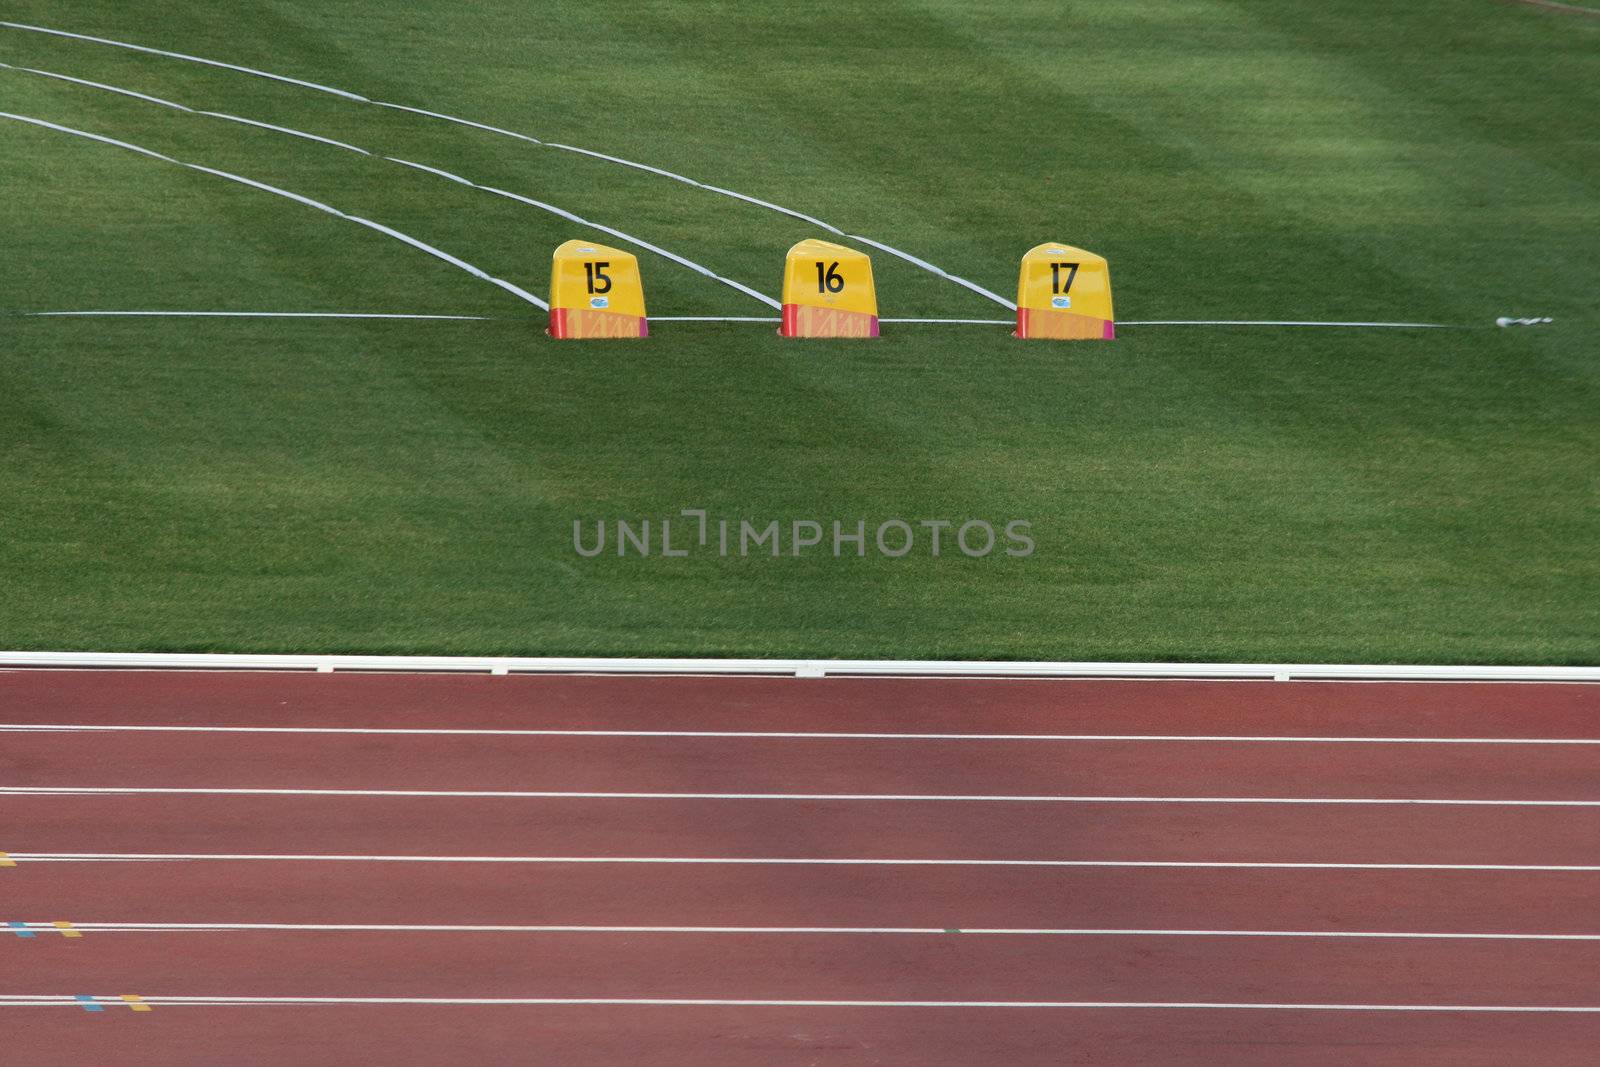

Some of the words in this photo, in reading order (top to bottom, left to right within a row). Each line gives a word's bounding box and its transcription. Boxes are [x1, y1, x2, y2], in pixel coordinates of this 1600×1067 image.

[584, 262, 612, 294] 15
[815, 261, 845, 294] 16
[1050, 262, 1080, 294] 17
